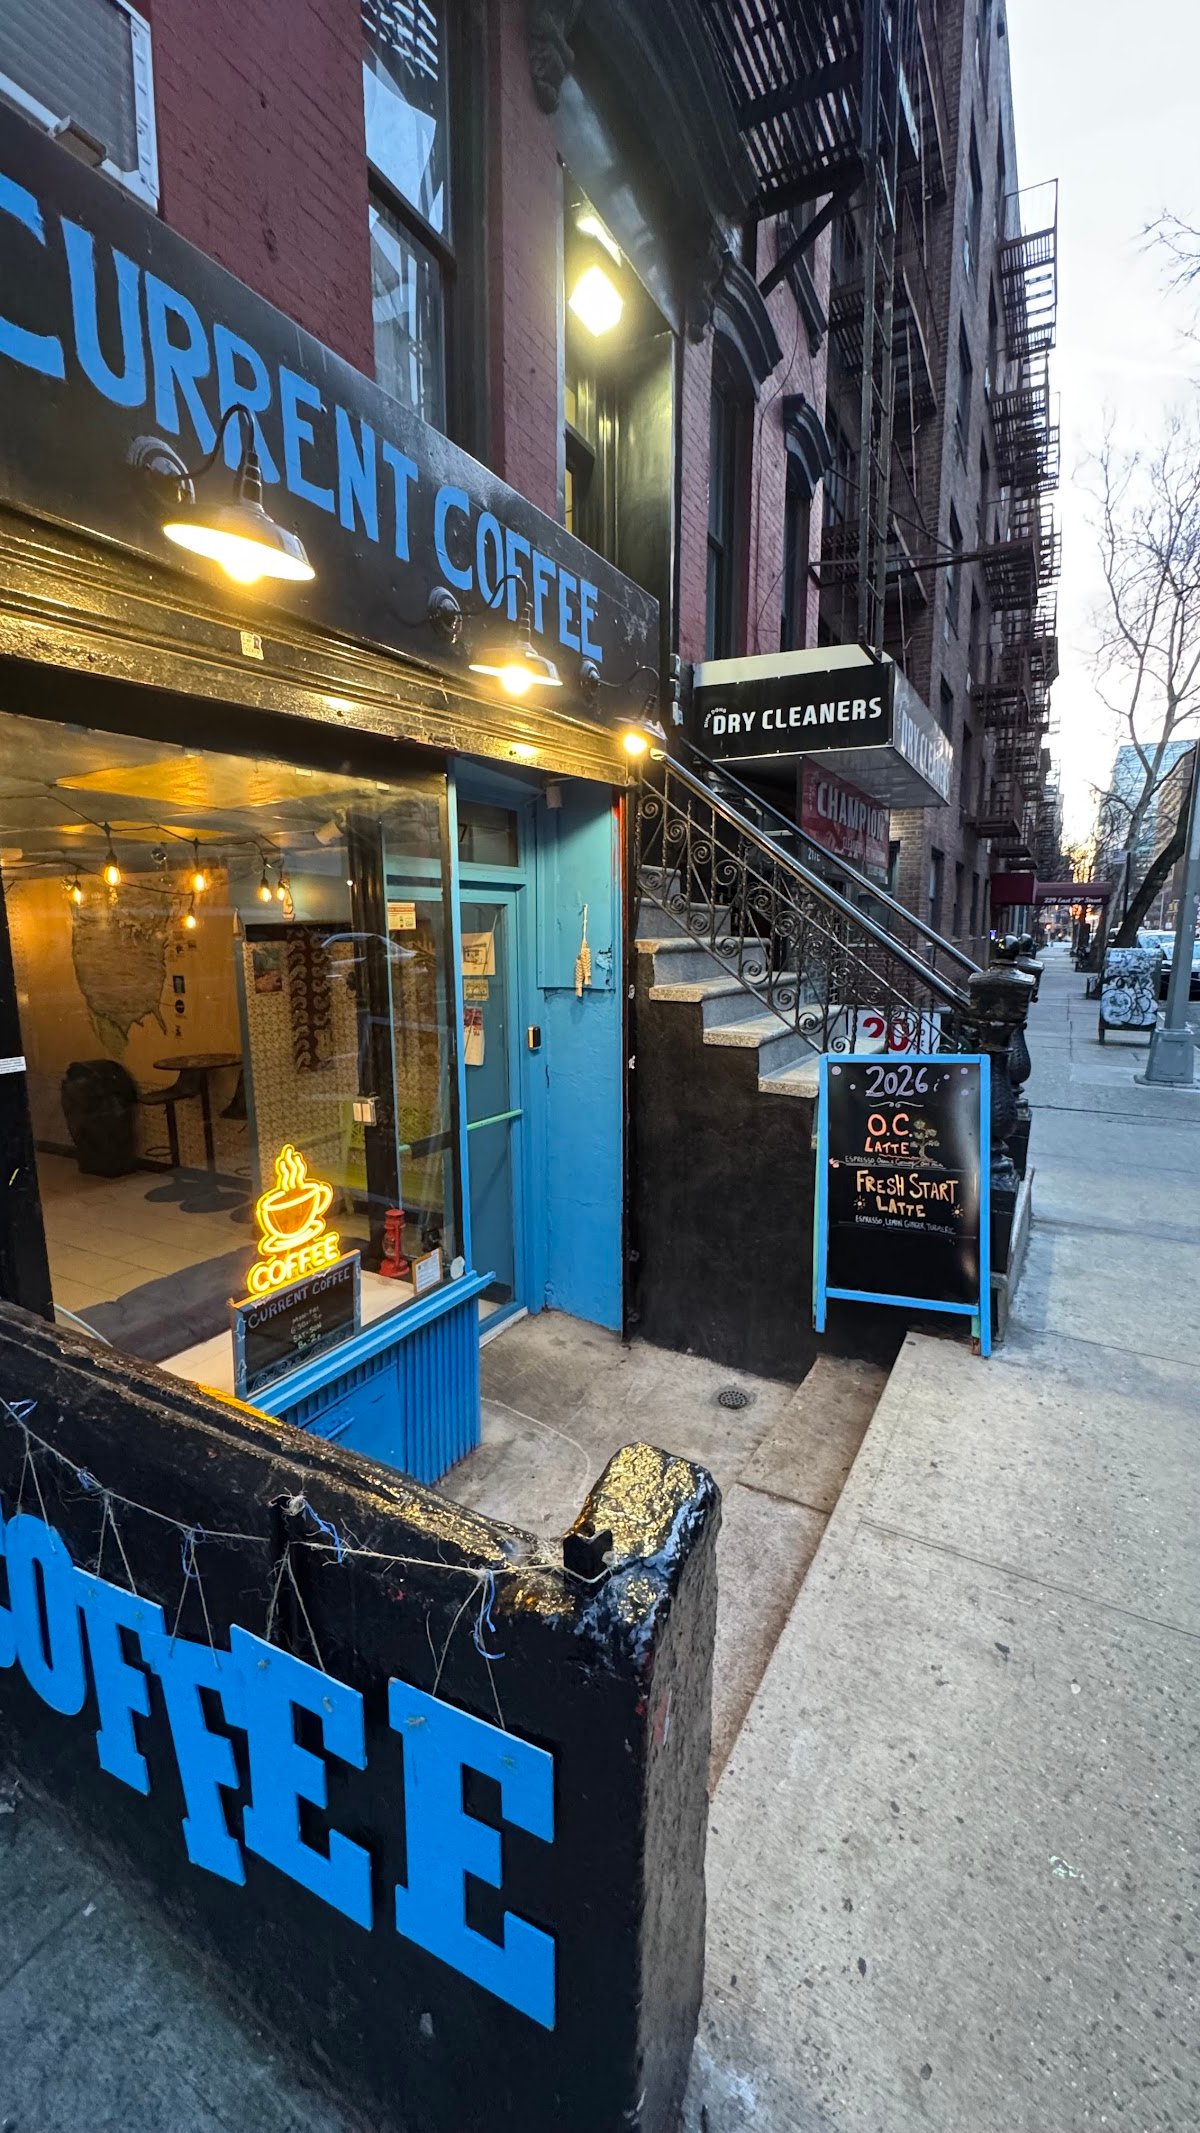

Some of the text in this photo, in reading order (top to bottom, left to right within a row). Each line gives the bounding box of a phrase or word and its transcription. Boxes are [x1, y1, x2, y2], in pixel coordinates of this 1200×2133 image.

[434, 486, 602, 663] COFFEE
[713, 711, 756, 735] DRY
[762, 697, 882, 730] CLEANERS
[901, 710, 919, 764] DRY
[817, 781, 885, 840] CHAMPION
[865, 1065, 929, 1097] 2026
[864, 1136, 910, 1155] LATTE
[867, 1113, 913, 1138] O.C.
[856, 1169, 959, 1204] FRESH START
[876, 1195, 926, 1218] LATTE
[249, 1232, 340, 1293] COFFEE
[247, 1267, 350, 1329] CURRENT COFFEE
[0, 1497, 555, 2031] OFFEE
